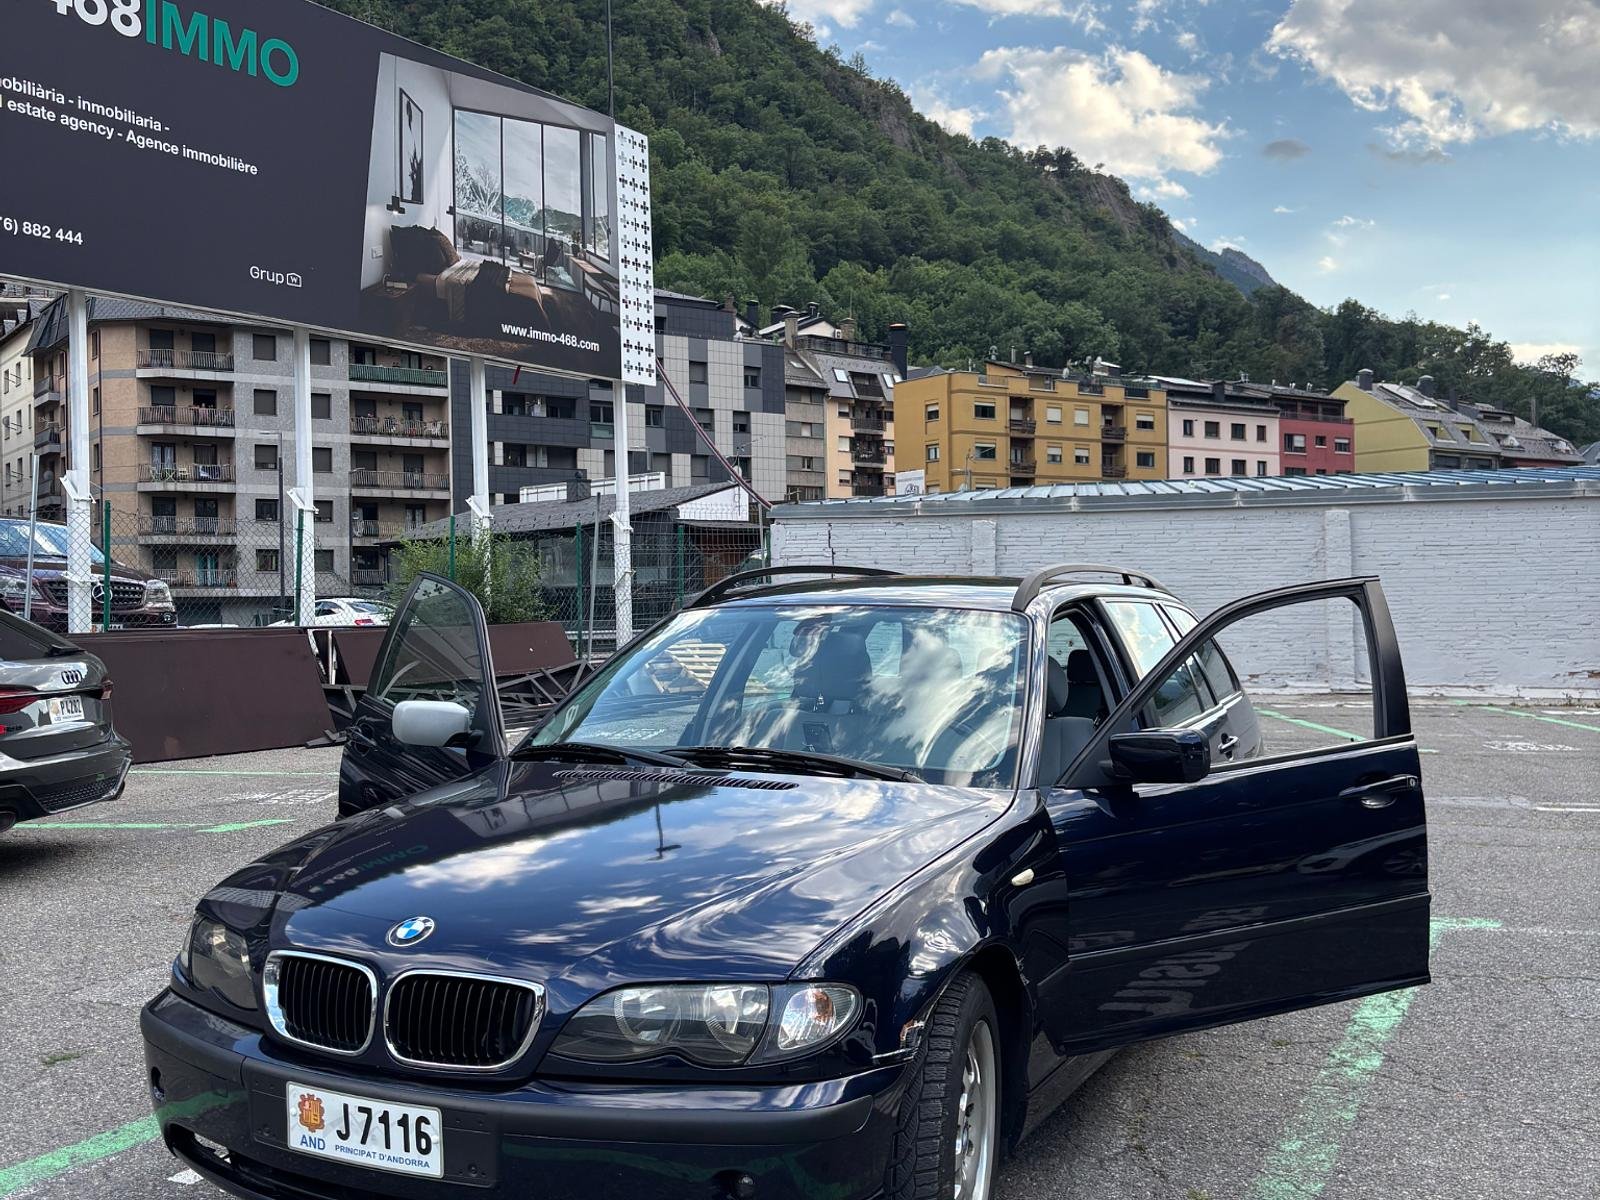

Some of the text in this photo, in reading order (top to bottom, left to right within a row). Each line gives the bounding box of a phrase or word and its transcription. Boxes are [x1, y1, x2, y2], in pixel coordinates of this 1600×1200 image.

[0, 77, 64, 105] obiliària
[77, 95, 162, 132] inmobiliaria
[7, 99, 56, 122] estate
[60, 113, 115, 140] agency
[126, 130, 180, 155] Agence
[182, 144, 258, 176] immobilière
[0, 216, 84, 246] 6) 882 444
[250, 265, 284, 285] Grup
[501, 323, 600, 353] www.immo-468.com
[300, 1134, 326, 1151] AND
[336, 1103, 432, 1156] J7116
[335, 1144, 430, 1169] PRINCIPAT D'ANDORRA
